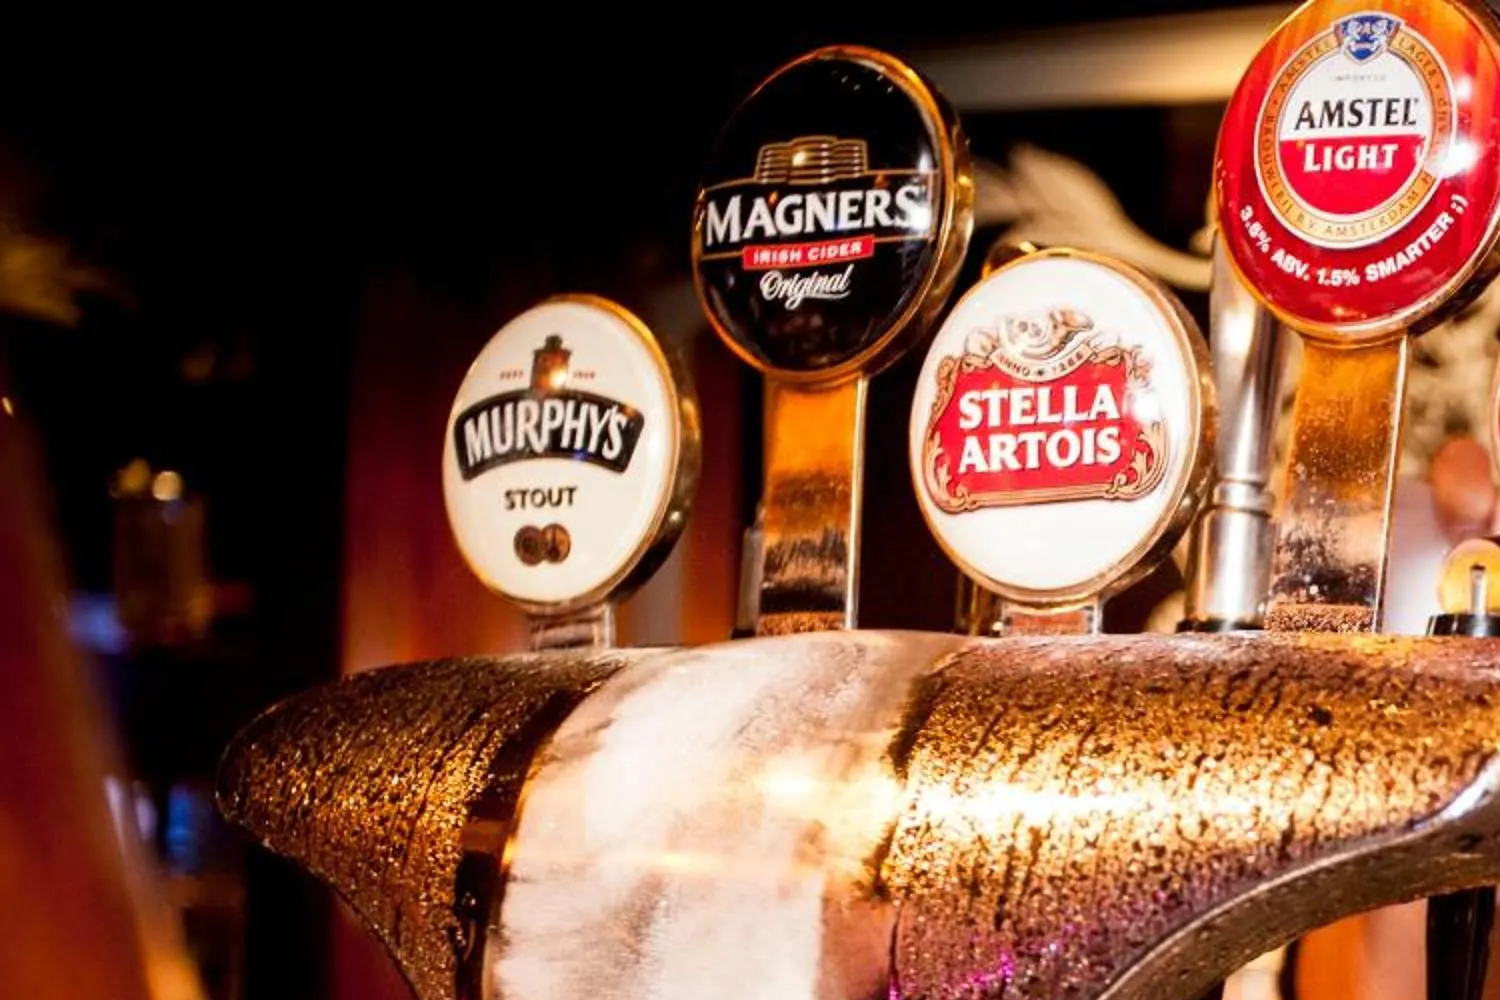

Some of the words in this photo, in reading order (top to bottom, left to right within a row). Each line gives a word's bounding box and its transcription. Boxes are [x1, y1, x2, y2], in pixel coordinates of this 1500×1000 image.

[1294, 98, 1416, 131] AMSTEL
[1303, 143, 1398, 173] LIGHT
[706, 186, 926, 246] MAGNERS
[753, 249, 803, 265] IRISH
[807, 241, 864, 261] CIDER
[1270, 248, 1310, 281] ABV.
[1317, 267, 1360, 286] 1.5%
[1365, 211, 1455, 282] SMARTER
[759, 263, 855, 311] Original
[958, 386, 1121, 430] STELLA
[463, 398, 629, 468] MURPHY'S
[958, 427, 1121, 474] ARTOIS
[504, 486, 578, 511] STOUT
